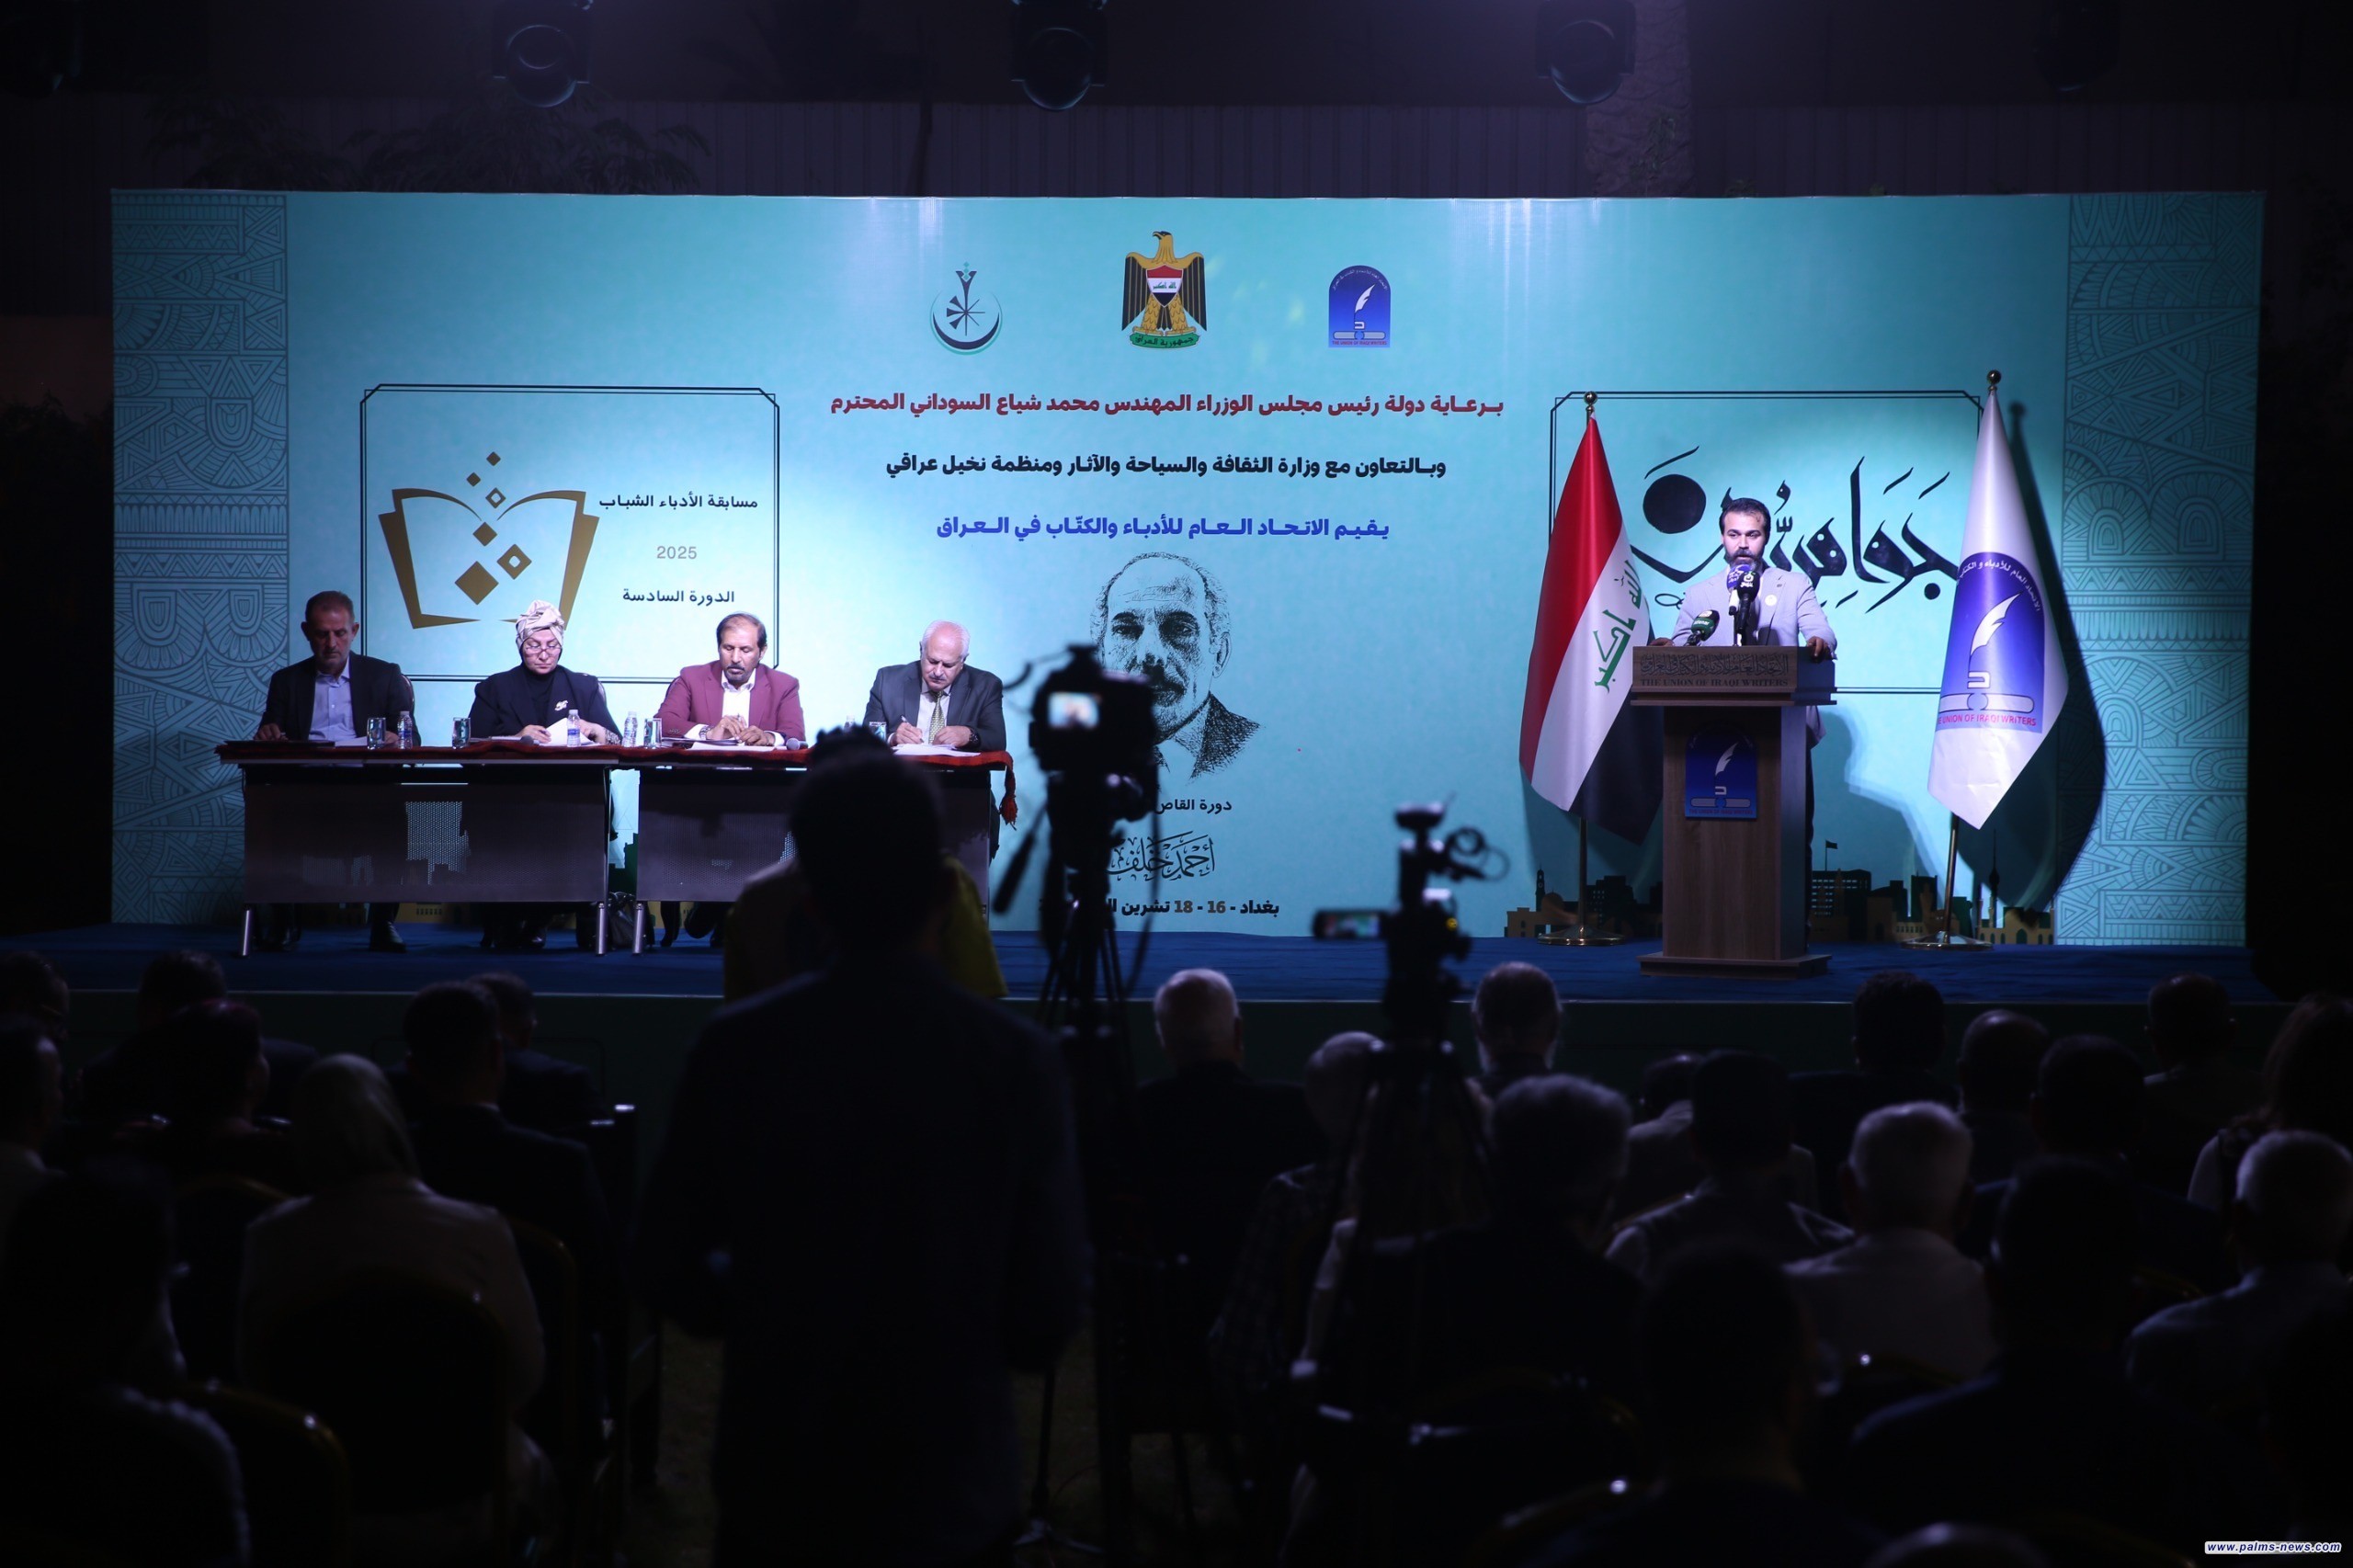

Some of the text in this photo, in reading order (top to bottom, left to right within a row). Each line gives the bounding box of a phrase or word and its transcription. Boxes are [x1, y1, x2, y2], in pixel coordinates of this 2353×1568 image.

[831, 392, 905, 415] المحترم
[910, 392, 991, 418] السوداني
[996, 393, 1041, 415] شياع
[1046, 398, 1100, 411] محمد
[1105, 394, 1192, 416] المهندس
[1197, 395, 1254, 416] الوزراء
[1258, 395, 1323, 415] مجلس
[1327, 396, 1380, 416] رئيس
[1384, 395, 1426, 417] دولة
[885, 457, 938, 478] عراقي
[942, 455, 986, 476] نخيل
[991, 456, 1063, 477] ومنظمة
[1066, 454, 1121, 476] والآثار
[1126, 455, 1208, 476] والسياحة
[1211, 454, 1273, 475] الثقافة
[1278, 458, 1321, 479] وزارة
[1324, 461, 1351, 479] مع
[598, 491, 758, 511] مسابقة الأدباء الشباب
[1015, 515, 1041, 541] في
[1122, 516, 1183, 540] للأدباء
[1257, 518, 1330, 536] الاتحاد
[1334, 519, 1390, 540] يقيم
[656, 546, 698, 560] 2025
[622, 588, 735, 607] الدورة السادسة
[1942, 714, 1963, 723] UNION
[1964, 713, 1975, 722] OF
[1976, 714, 2000, 723] IRAQI
[2001, 715, 2037, 726] WRITERS
[1199, 799, 1233, 814] دورة
[1121, 900, 1170, 915] تشرين
[1174, 901, 1193, 914] 18
[1207, 901, 1226, 914] 16
[1240, 900, 1280, 917] بغداد
